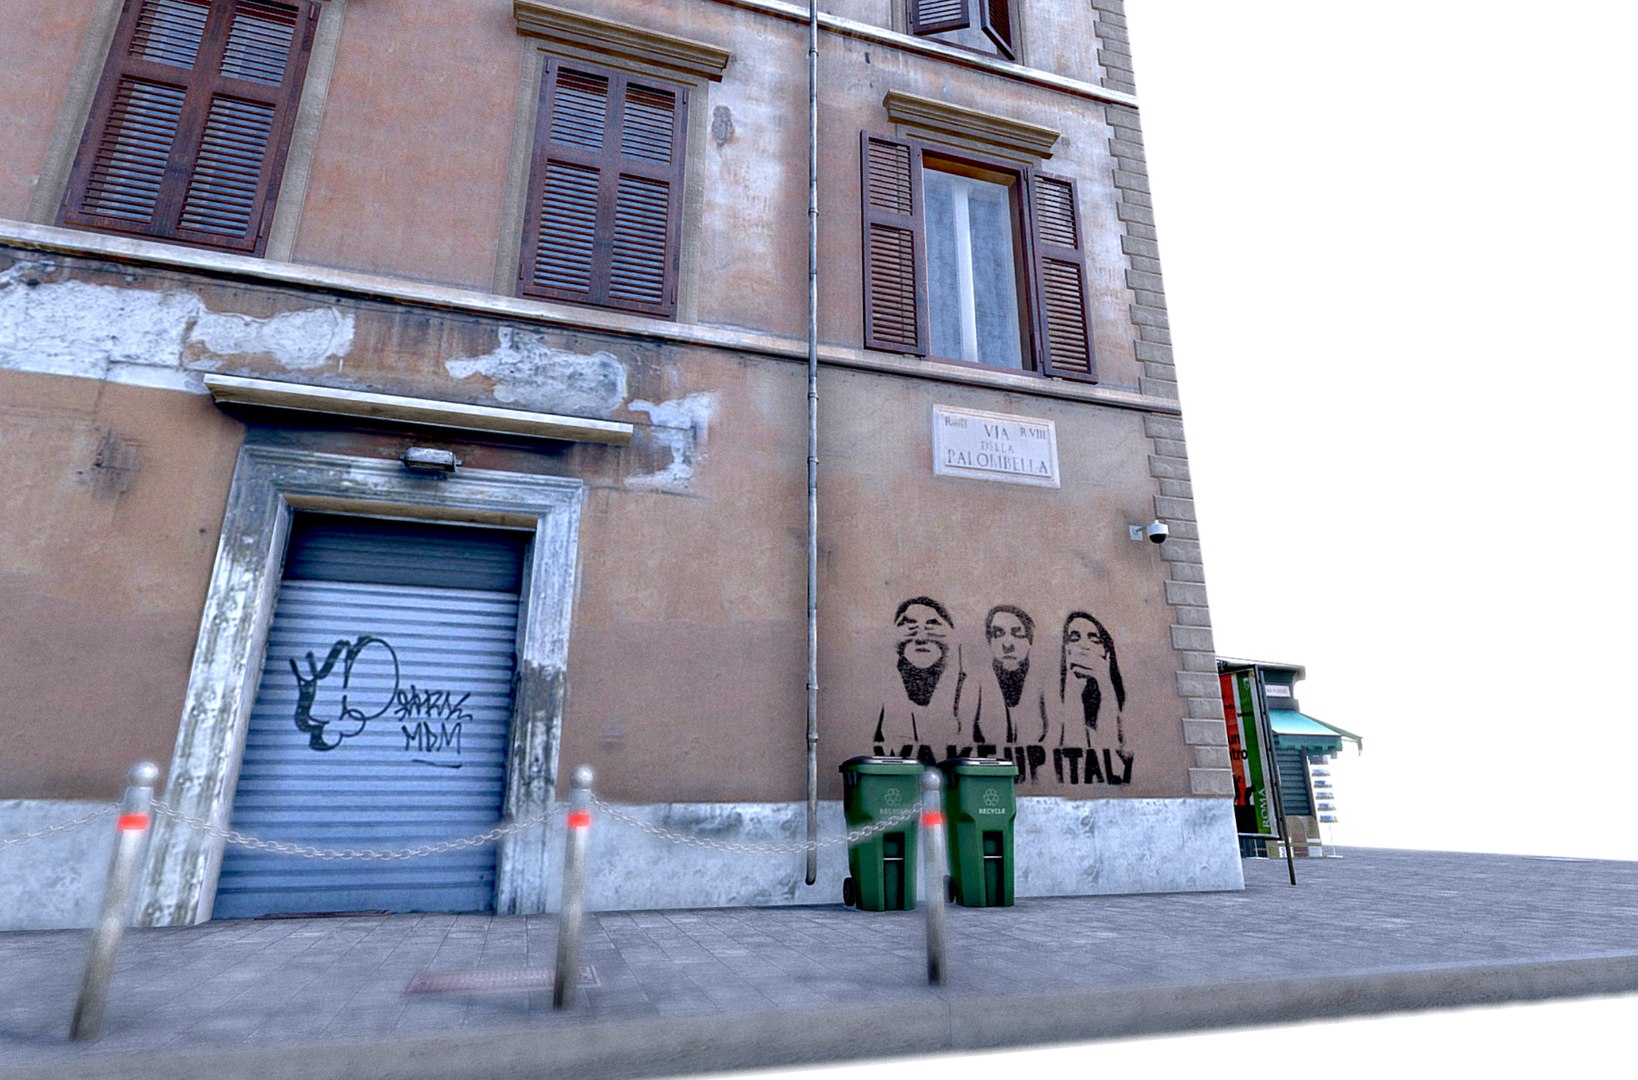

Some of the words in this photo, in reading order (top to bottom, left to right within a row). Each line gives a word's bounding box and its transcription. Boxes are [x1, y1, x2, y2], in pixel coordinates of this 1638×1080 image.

[984, 424, 1010, 441] VIA
[981, 440, 1015, 454] DELLA
[1053, 747, 1135, 785] ITALY
[1258, 788, 1271, 828] ROMA
